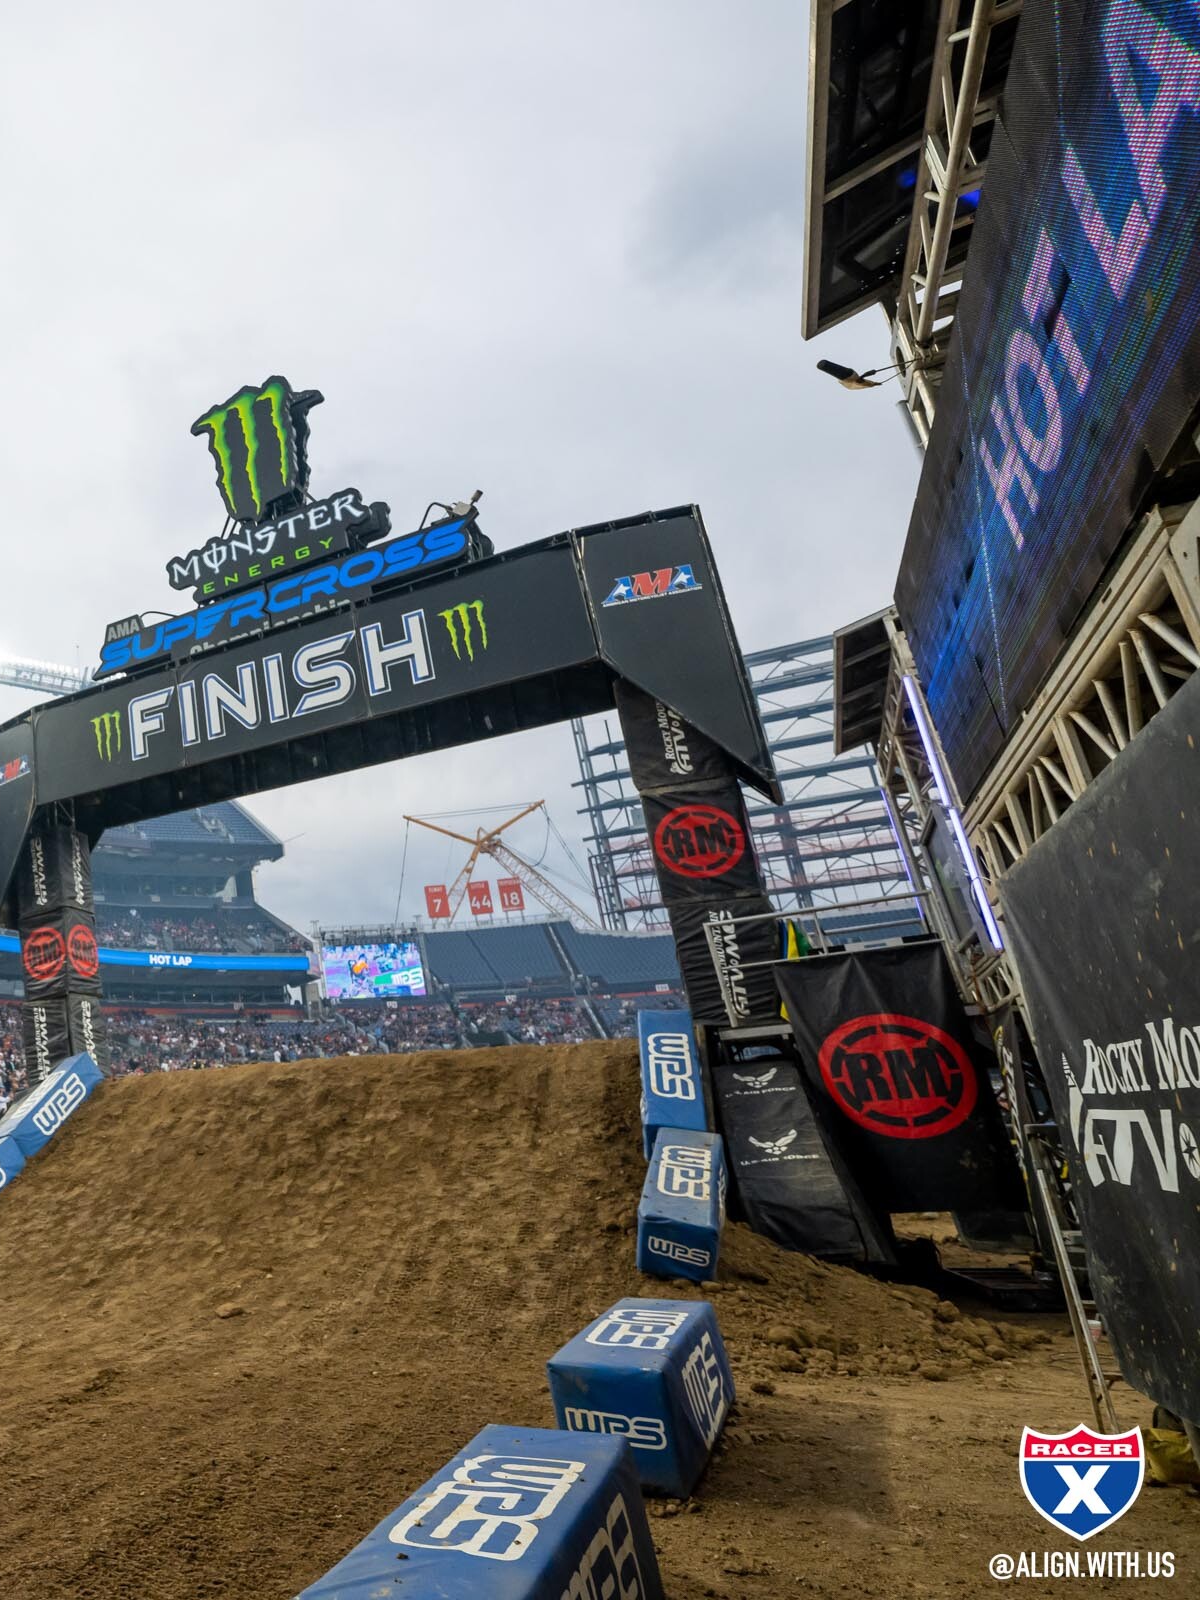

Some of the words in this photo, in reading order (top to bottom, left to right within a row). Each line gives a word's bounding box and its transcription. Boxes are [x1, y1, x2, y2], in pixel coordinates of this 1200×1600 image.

[980, 228, 1093, 550] HOT
[170, 494, 364, 585] MONSTER
[203, 536, 333, 594] ENERGY
[100, 519, 467, 672] SUPERCROSS
[601, 564, 702, 605] AMA
[107, 618, 140, 642] AMA
[127, 608, 436, 762] FINISH
[432, 899, 442, 913] 7
[471, 896, 491, 910] 44
[503, 892, 521, 906] 18
[149, 954, 171, 965] HOT
[173, 955, 193, 966] LAP
[647, 1032, 696, 1101] WPS
[836, 1042, 951, 1106] RM
[1081, 1038, 1151, 1095] ROCKY
[1144, 1017, 1200, 1091] MO
[32, 1073, 87, 1136] WPS
[657, 1144, 712, 1201] WPS
[1083, 1108, 1180, 1194] ATV
[648, 1235, 711, 1268] WPS
[564, 1407, 668, 1450] WPS
[388, 1454, 586, 1561] WPS
[560, 1492, 647, 1600] PS
